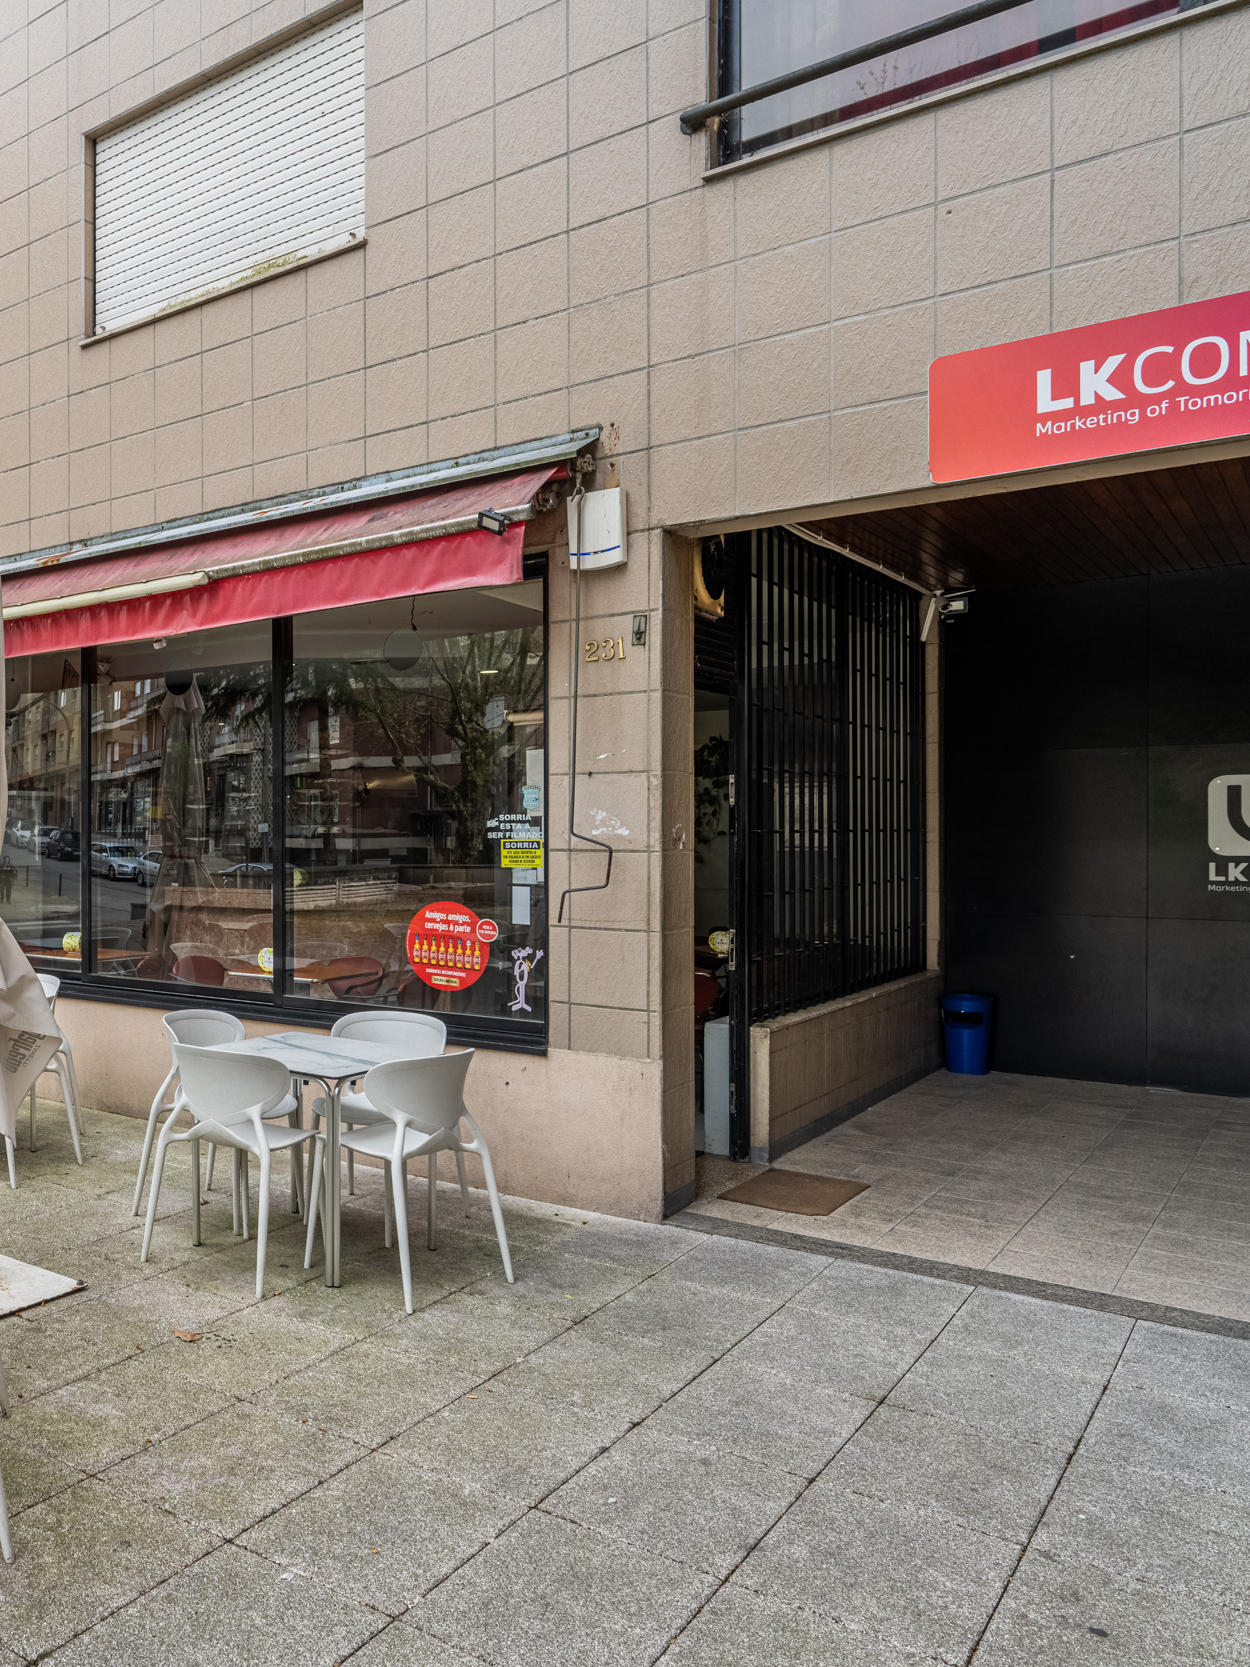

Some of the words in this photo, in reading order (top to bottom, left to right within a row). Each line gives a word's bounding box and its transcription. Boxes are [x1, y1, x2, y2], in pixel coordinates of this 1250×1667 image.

[1036, 330, 1250, 414] LKCO
[1036, 410, 1140, 437] Marketing
[1146, 399, 1170, 418] of
[1175, 388, 1250, 412] Tomor
[585, 637, 627, 663] 231
[487, 831, 504, 839] SER
[506, 831, 544, 839] FILMADO
[424, 921, 449, 932] cervejas
[454, 924, 471, 933] parte
[425, 910, 447, 922] Amigos
[447, 912, 471, 924] amigos,
